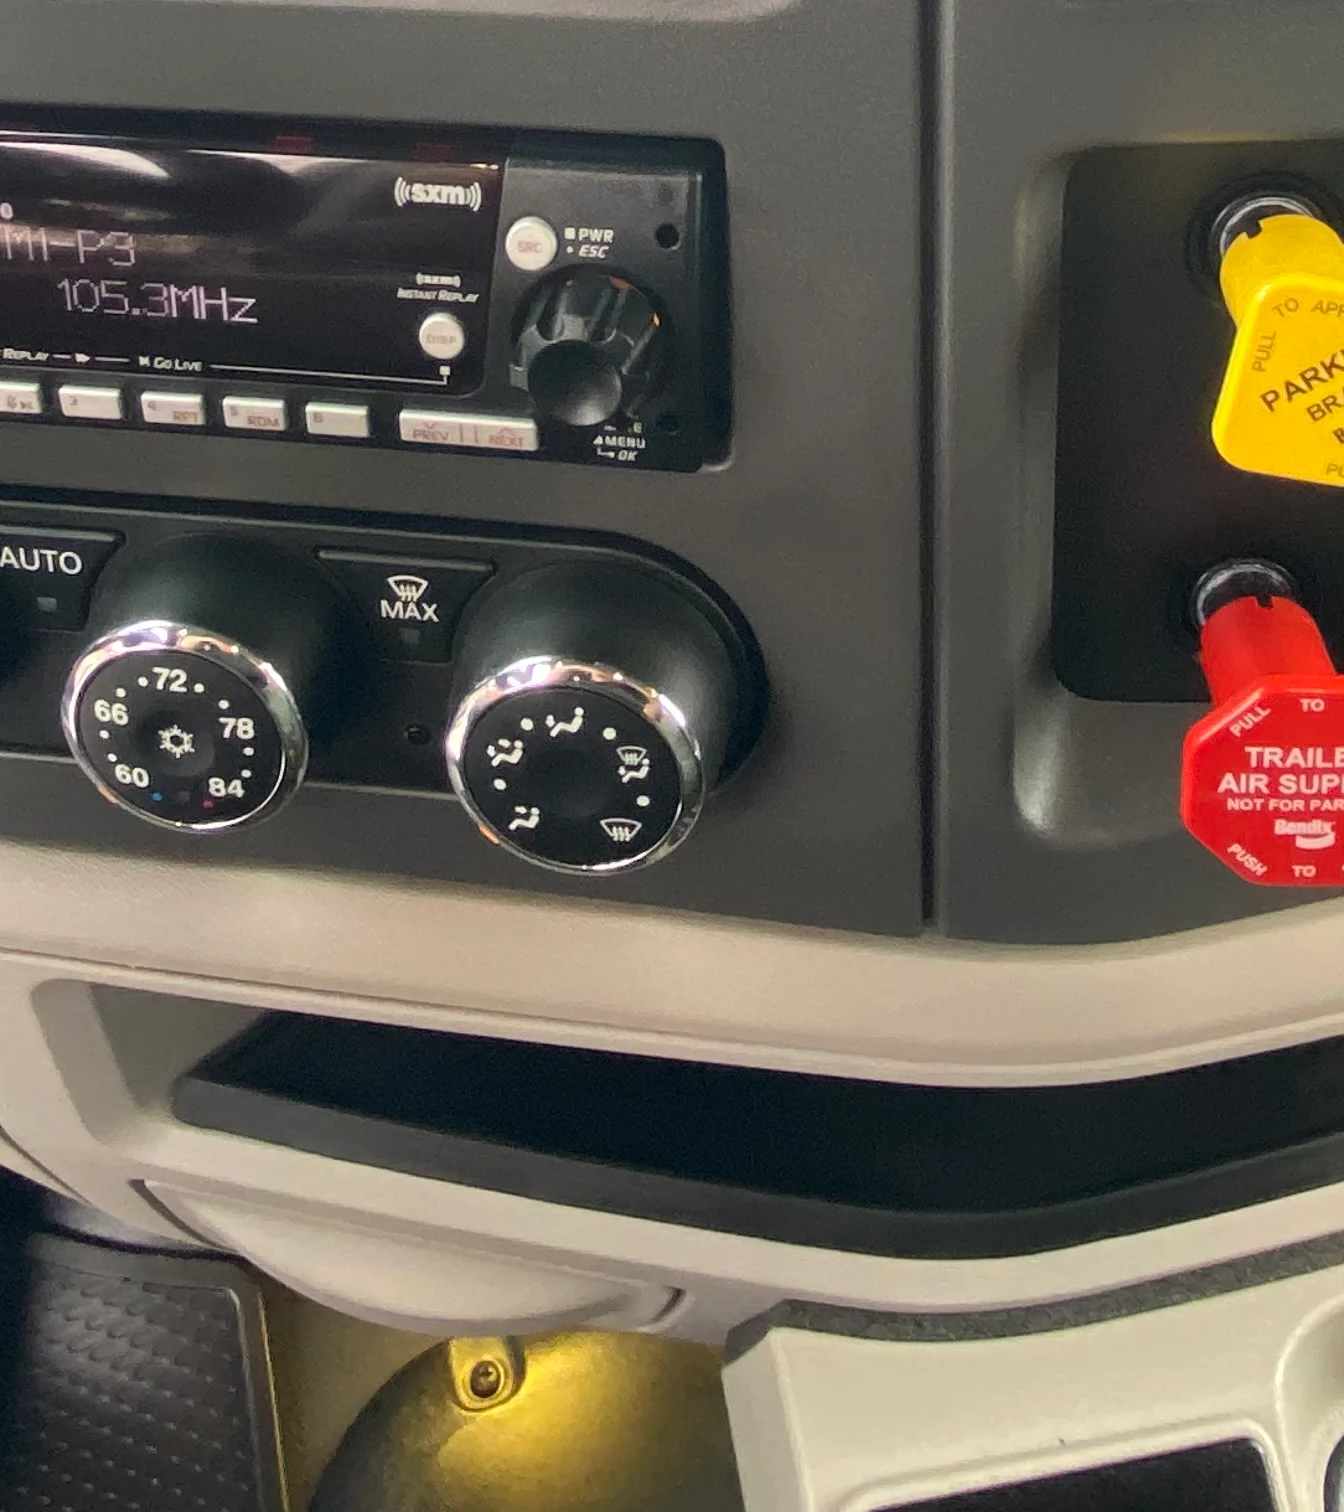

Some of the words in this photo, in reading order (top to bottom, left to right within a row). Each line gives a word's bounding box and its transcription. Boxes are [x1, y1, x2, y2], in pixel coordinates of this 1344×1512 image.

[578, 228, 614, 243] PWR
[578, 244, 610, 259] ESC
[57, 278, 258, 323] 105.3MHz
[1272, 298, 1299, 319] TO
[1251, 330, 1277, 373] PULL
[605, 435, 646, 449] MENU
[617, 449, 639, 462] OK
[0, 546, 83, 575] AUTO
[380, 598, 440, 623] MAX
[152, 667, 188, 693] 72
[93, 699, 130, 726] 66
[1228, 702, 1272, 738] PULL
[1299, 697, 1325, 713] TO
[219, 716, 255, 739] 78
[114, 763, 150, 789] 60
[1216, 772, 1271, 794] AIR
[208, 777, 245, 799] 84
[1226, 798, 1265, 811] NOT
[1268, 798, 1305, 812] FOR
[1273, 818, 1337, 836] Bendix
[1227, 842, 1269, 877] PUSH
[1291, 864, 1317, 878] TO
